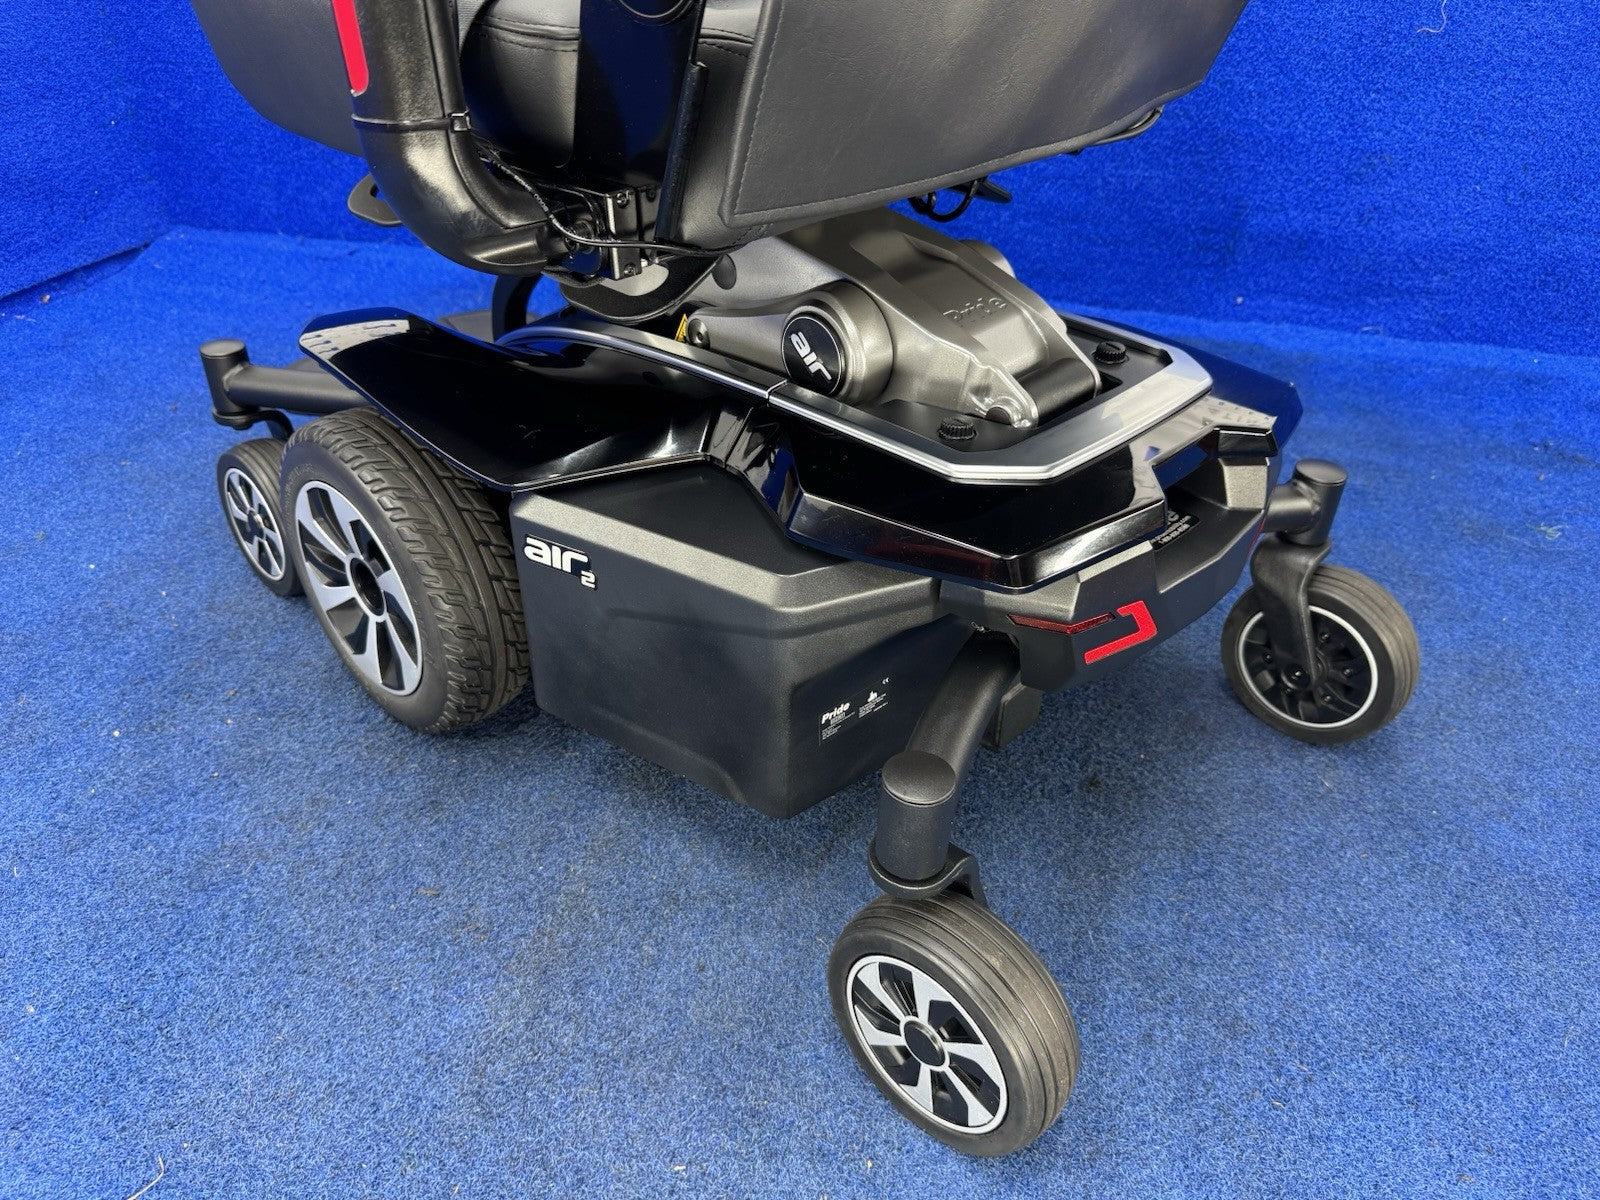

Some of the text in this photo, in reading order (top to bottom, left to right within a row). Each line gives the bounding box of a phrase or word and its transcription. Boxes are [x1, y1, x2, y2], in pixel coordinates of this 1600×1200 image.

[790, 331, 832, 380] air
[524, 537, 596, 588] air 2
[821, 702, 850, 725] Pride
